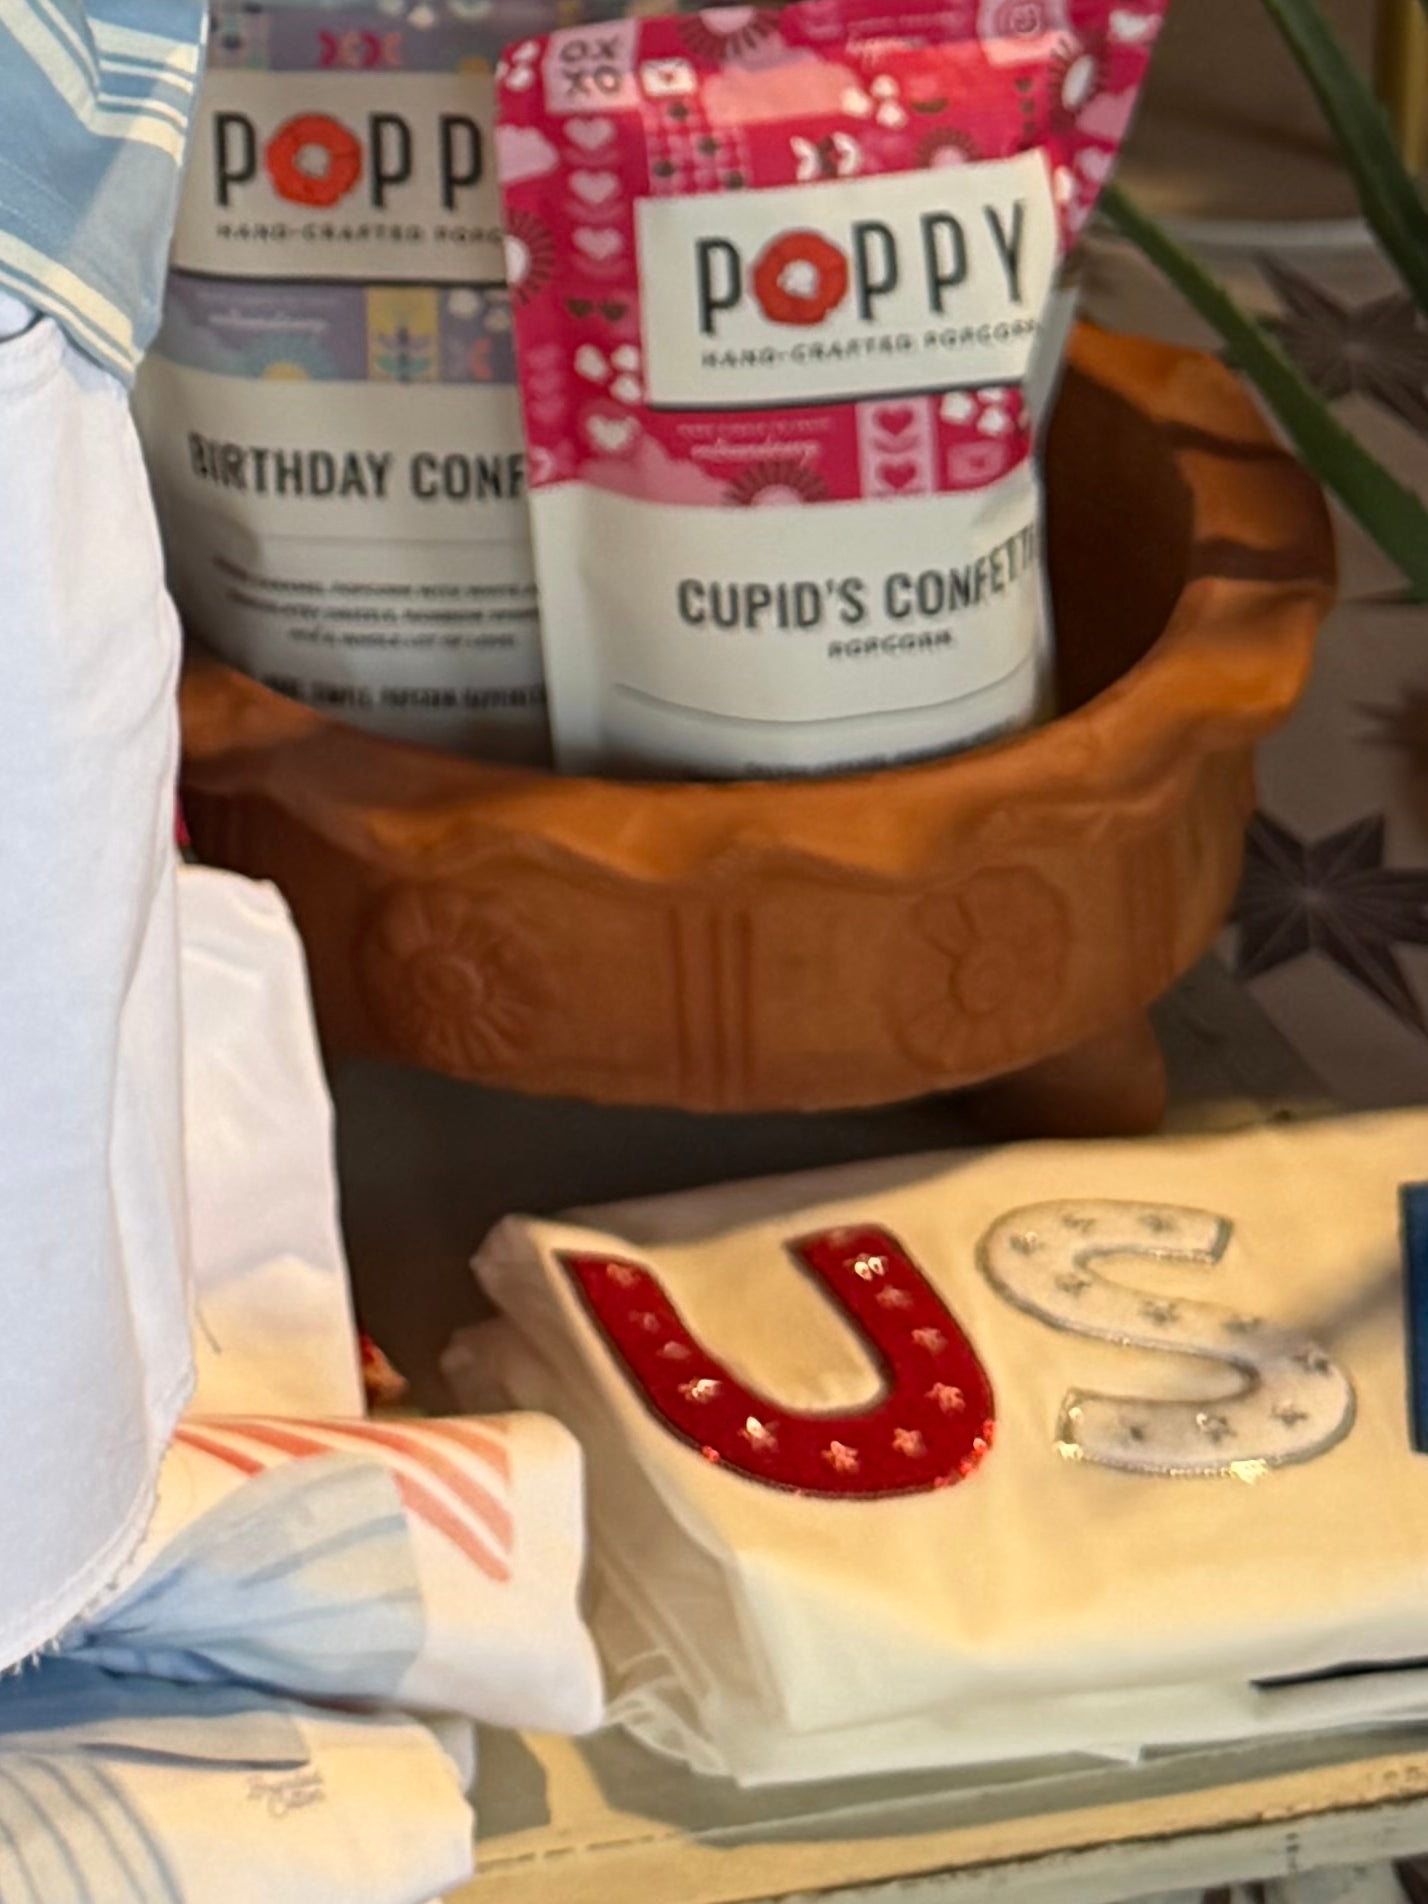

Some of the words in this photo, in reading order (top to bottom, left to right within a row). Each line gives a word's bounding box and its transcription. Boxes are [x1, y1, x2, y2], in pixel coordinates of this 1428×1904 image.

[213, 109, 484, 211] POPP
[694, 198, 1026, 336] POPPY
[187, 430, 392, 499] BIRTHDAY
[408, 451, 526, 501] CONF
[676, 578, 866, 629] CUPID'S
[827, 627, 954, 661] POPCORN
[552, 1180, 1428, 1502] US
